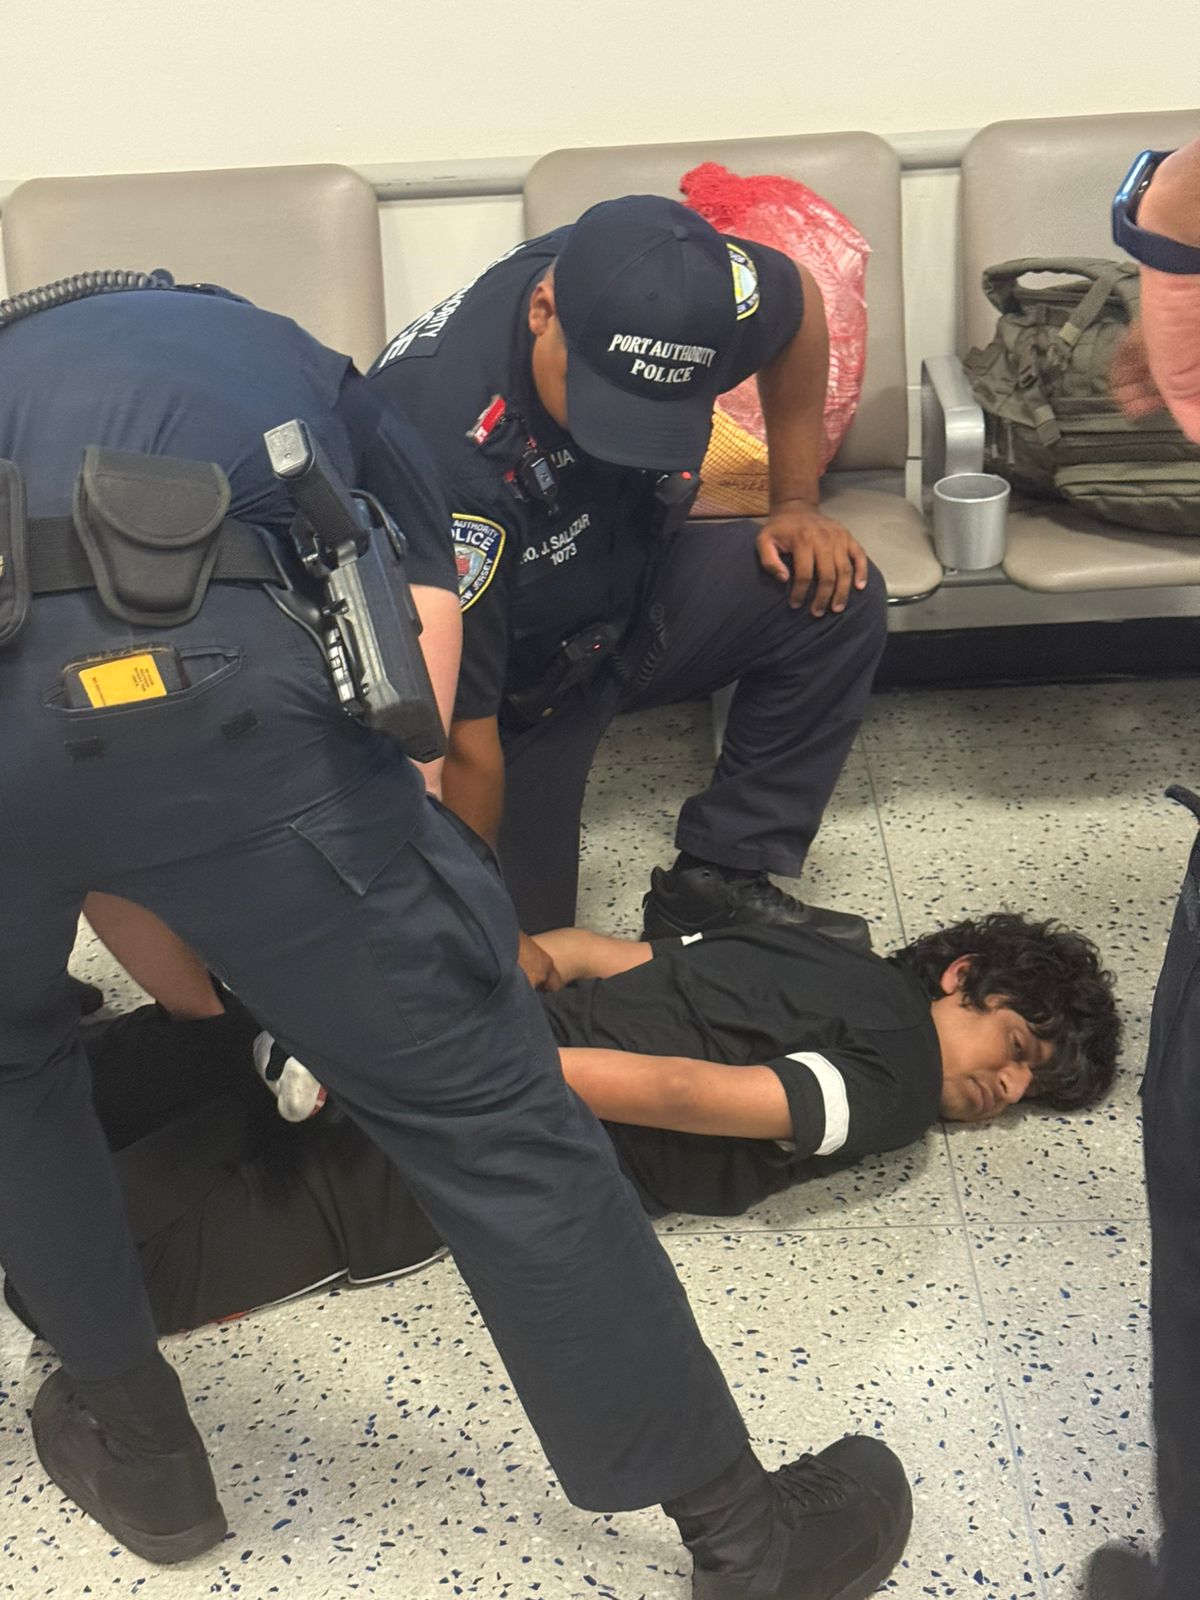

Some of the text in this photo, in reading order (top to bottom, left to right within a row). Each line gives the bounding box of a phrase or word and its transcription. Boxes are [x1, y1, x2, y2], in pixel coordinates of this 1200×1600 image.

[607, 333, 717, 368] PORT AUTHORITY
[630, 358, 695, 384] POLICE
[451, 528, 495, 551] LICE
[453, 520, 499, 539] AUTHORITY
[549, 513, 591, 549] SALAZAR
[550, 542, 577, 566] 1073
[472, 558, 493, 591] JERSEY
